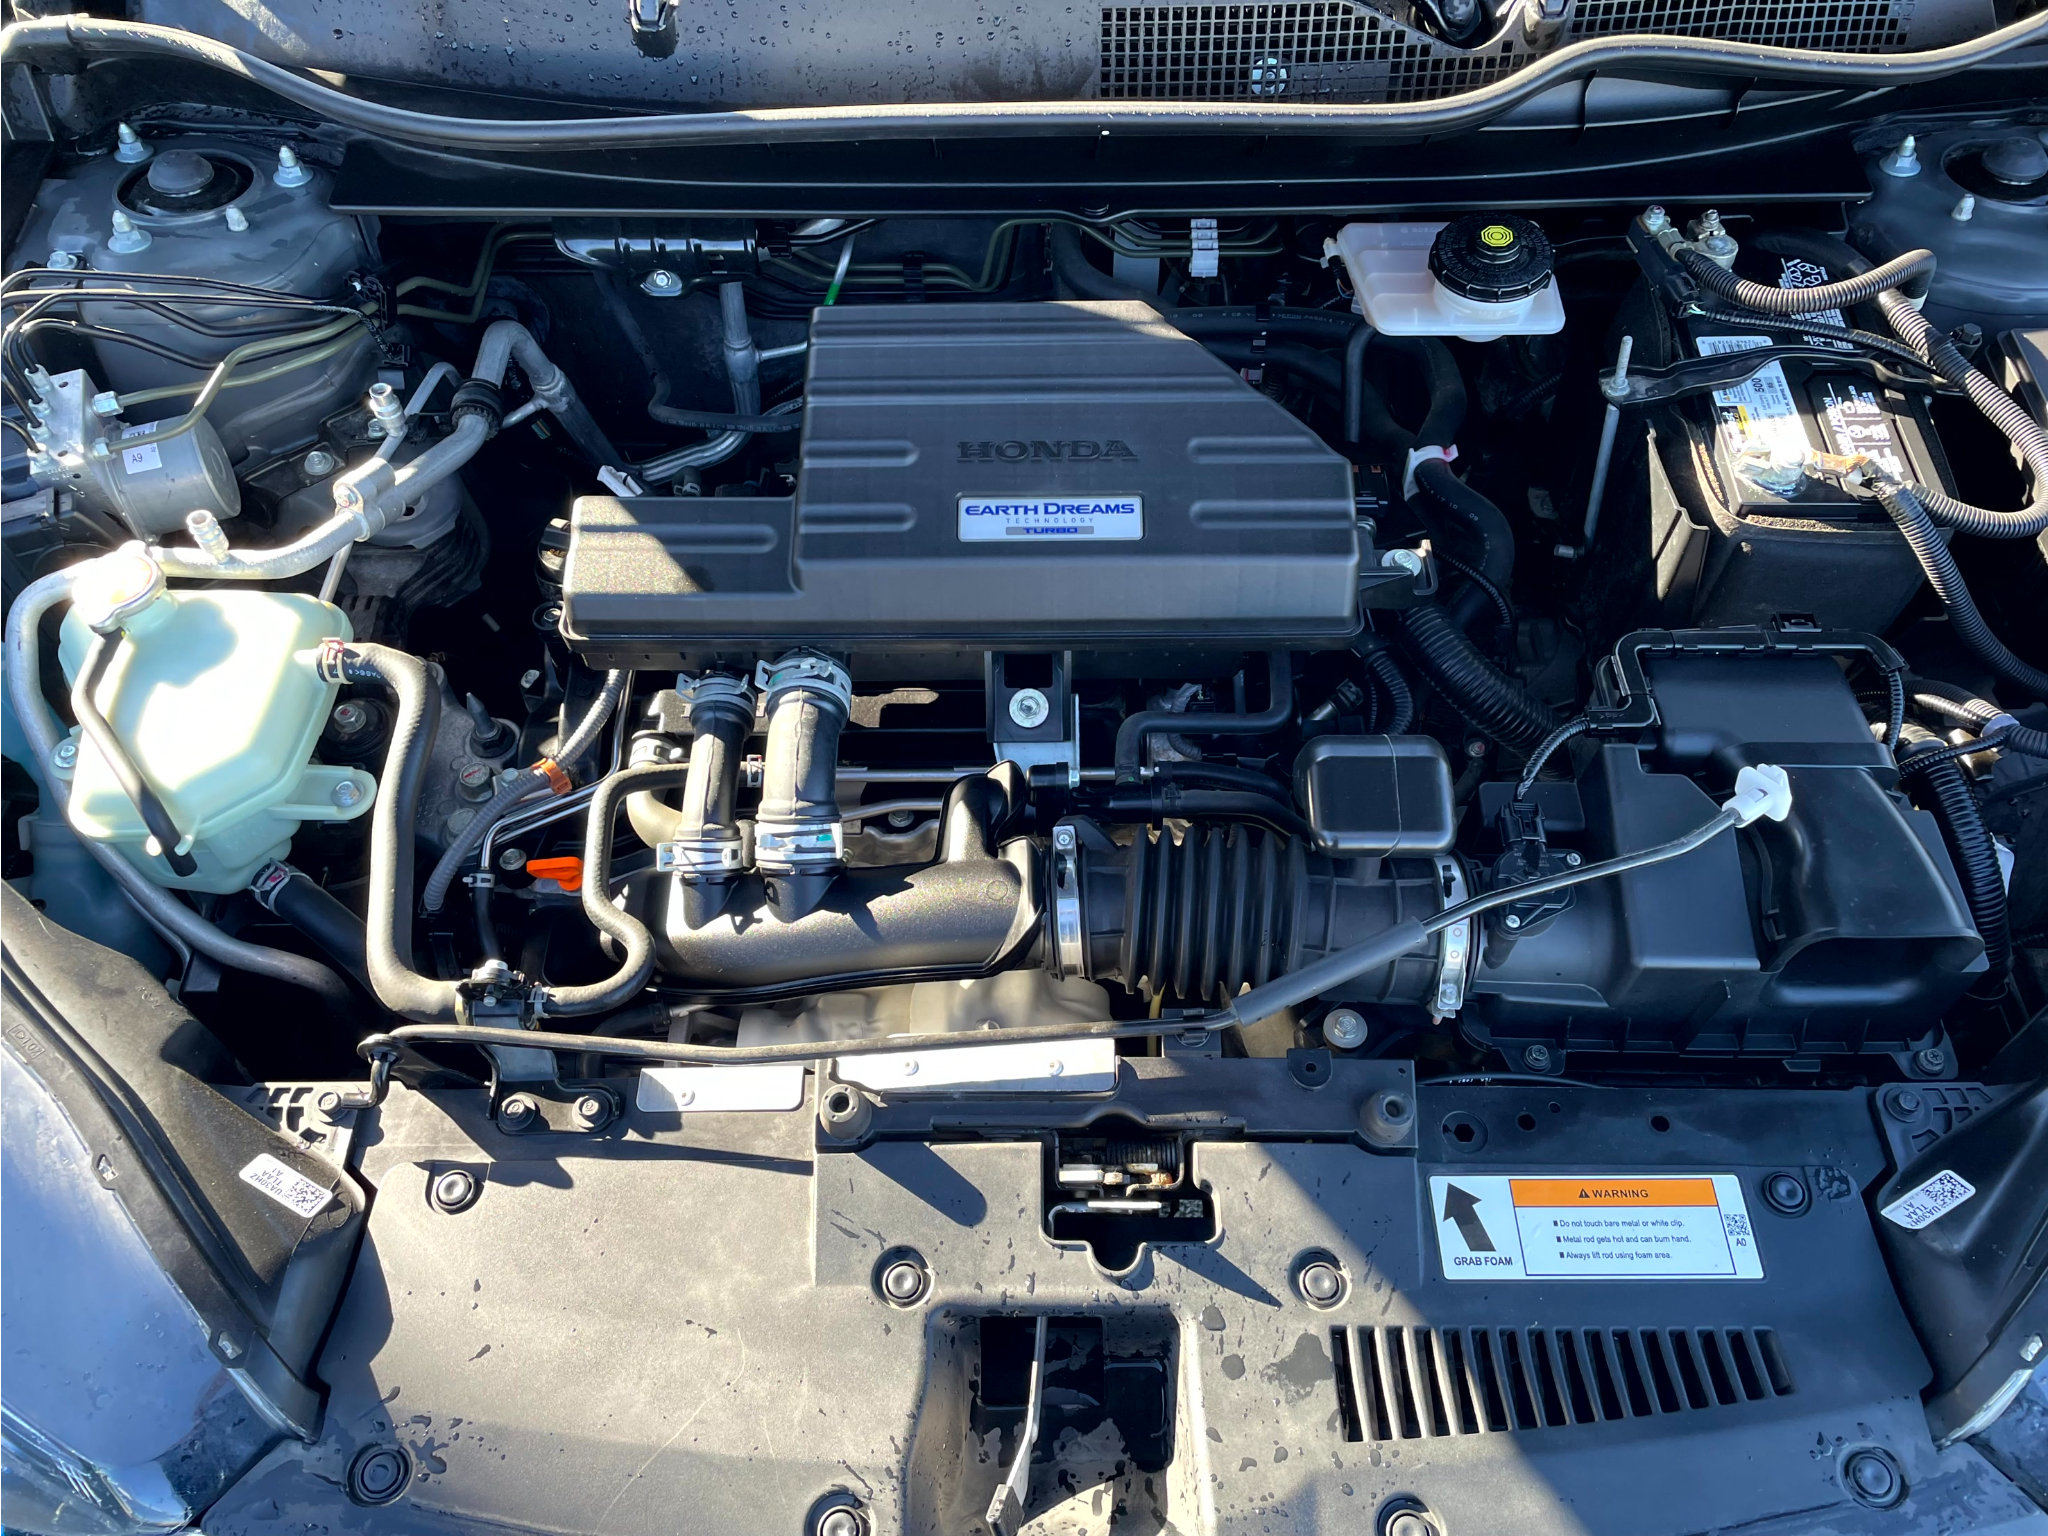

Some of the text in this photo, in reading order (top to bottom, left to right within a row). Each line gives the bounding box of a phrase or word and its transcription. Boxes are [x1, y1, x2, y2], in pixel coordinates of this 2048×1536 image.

[1751, 377, 1765, 393] 500
[957, 440, 1139, 462] HONDA
[132, 453, 143, 463] A9
[965, 503, 1135, 515] EARTH DREAMS
[1591, 1189, 1649, 1199] WARNING
[1904, 1204, 1929, 1219] TLAA
[1604, 1219, 1620, 1227] bare
[1621, 1219, 1641, 1227] metal
[1650, 1219, 1669, 1227] white
[1562, 1235, 1582, 1243] Metal
[1583, 1235, 1595, 1243] rod
[1596, 1236, 1611, 1245] gets
[1612, 1235, 1624, 1243] hot
[1625, 1235, 1639, 1243] and
[1671, 1235, 1692, 1243] hand.
[1453, 1256, 1513, 1266] GRAB FOAM
[1566, 1251, 1591, 1261] Always
[1592, 1251, 1601, 1259] lift
[1602, 1251, 1614, 1259] rod
[1615, 1252, 1634, 1261] using
[1635, 1251, 1653, 1259] foam
